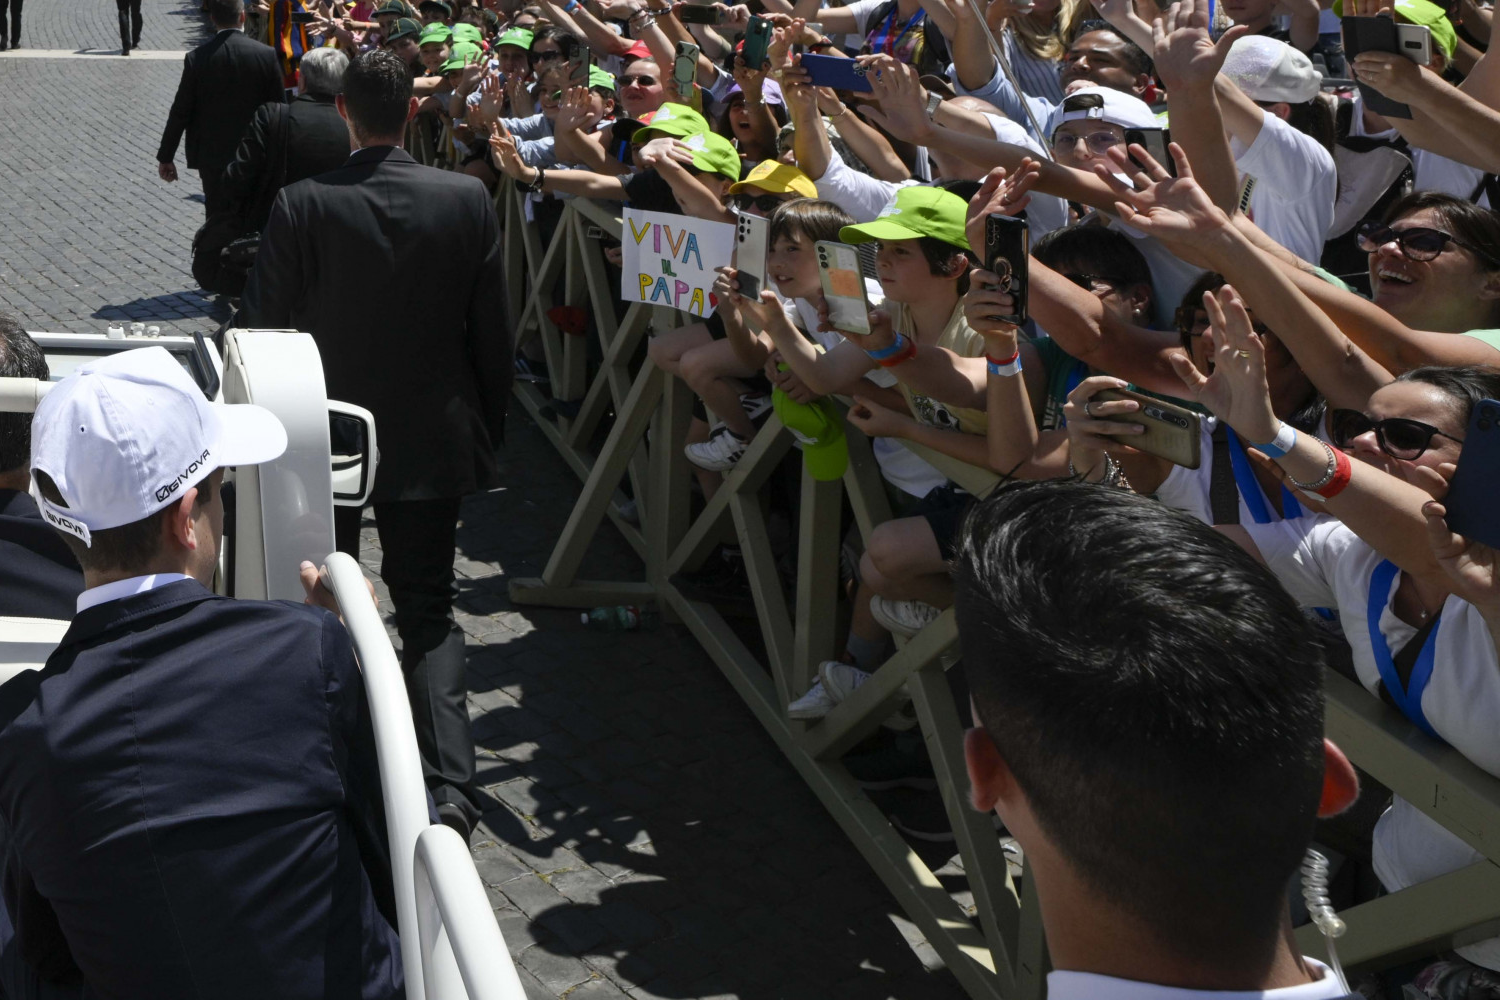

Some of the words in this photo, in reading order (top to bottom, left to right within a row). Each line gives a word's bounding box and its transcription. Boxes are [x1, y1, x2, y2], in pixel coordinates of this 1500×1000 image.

[627, 217, 704, 271] VIVA
[661, 258, 677, 278] IL
[638, 273, 705, 318] PAPA
[168, 448, 211, 494] GIVOVA
